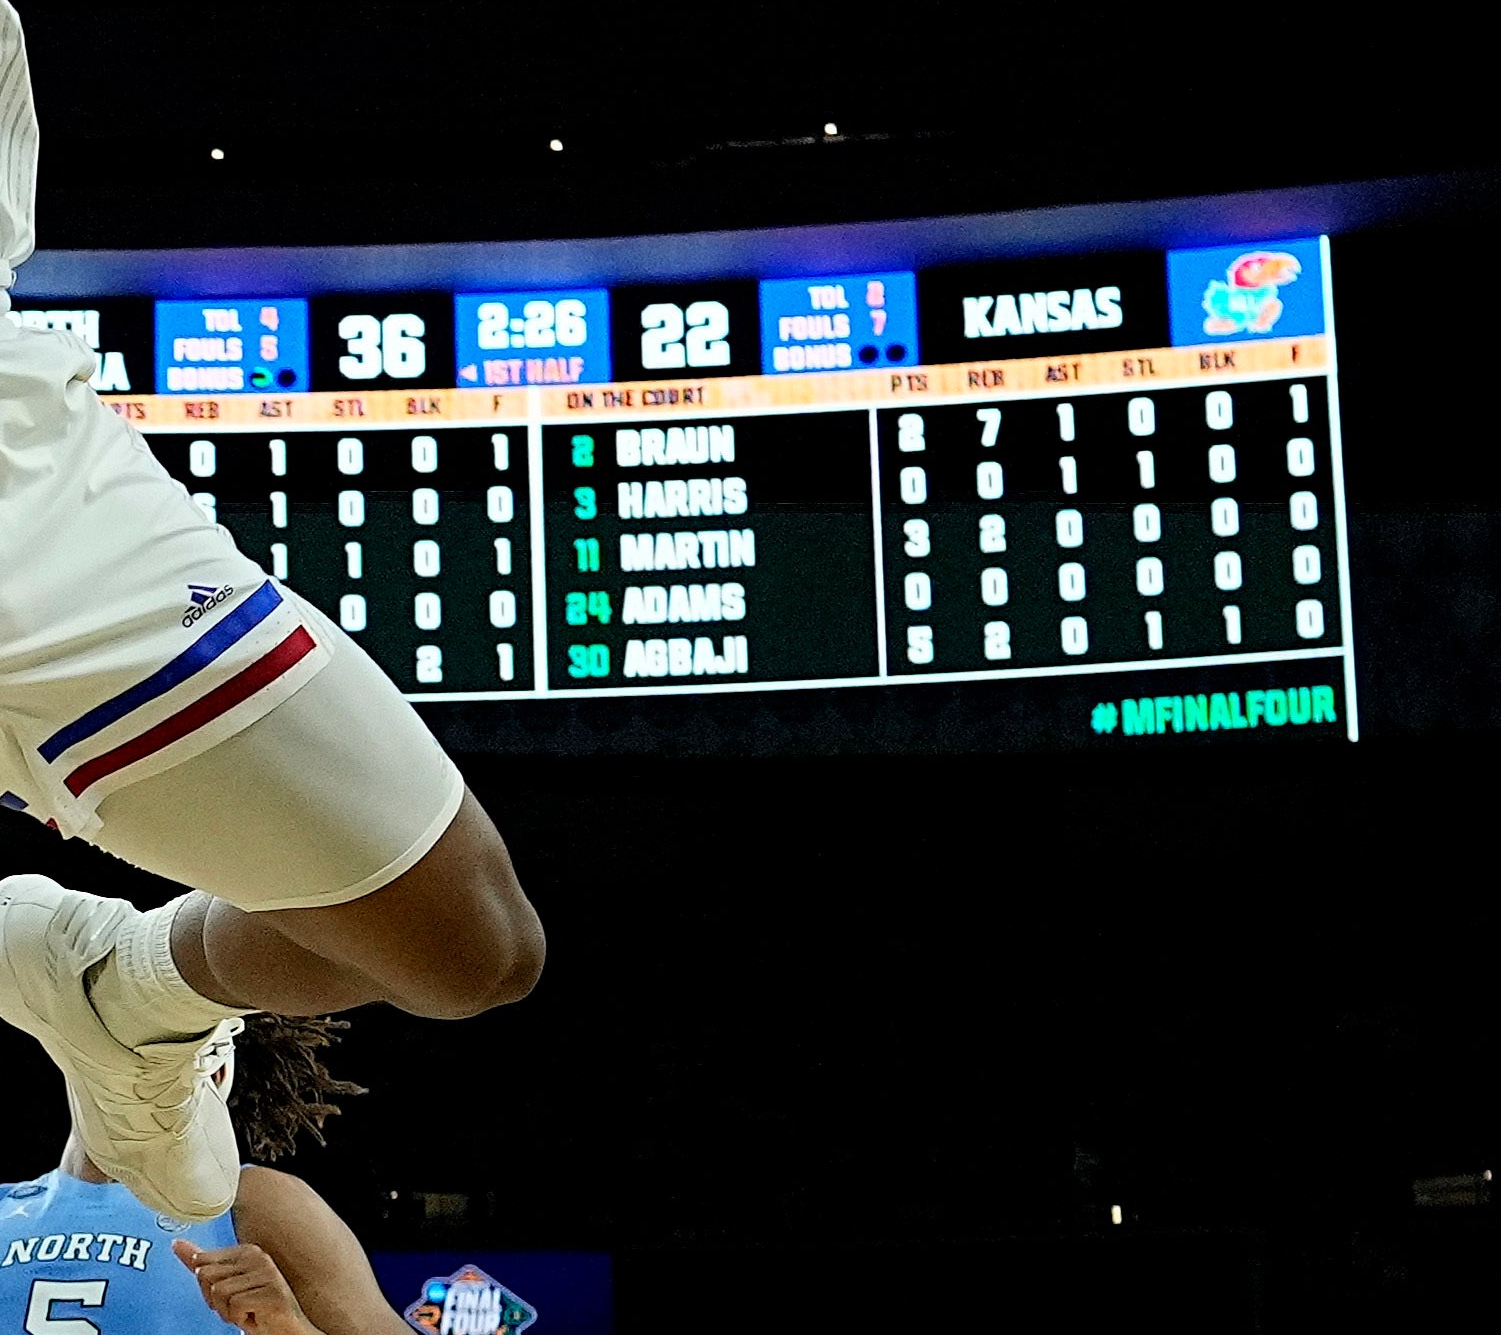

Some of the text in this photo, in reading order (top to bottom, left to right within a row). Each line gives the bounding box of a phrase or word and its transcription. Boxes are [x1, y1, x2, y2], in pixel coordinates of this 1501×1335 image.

[477, 299, 587, 350] 2:26
[778, 309, 887, 341] FOULS 7
[962, 286, 1124, 338] KANSAS
[173, 337, 244, 362] FOULS
[338, 313, 426, 380] 36
[641, 300, 731, 370] 22
[525, 356, 584, 385] HALF
[773, 343, 853, 372] BONUS
[567, 386, 706, 410] ON THE COURT
[891, 373, 928, 393] PTS
[333, 398, 365, 417] STL
[615, 424, 736, 467] BRAUN
[977, 408, 1001, 447] 7
[1057, 403, 1075, 441] 1
[1128, 397, 1155, 436] 0
[1206, 391, 1233, 430] 0
[1289, 384, 1308, 423] 1
[190, 434, 509, 477] 0 1 0 0 1
[618, 477, 748, 519] HARRIS
[900, 467, 927, 504] 0
[977, 462, 1003, 499] 0
[1059, 456, 1077, 494] 1
[1136, 451, 1155, 488] 1
[1209, 444, 1236, 483] 0
[1287, 438, 1315, 476] 0
[270, 486, 513, 528] 1 0 0 0
[573, 538, 600, 572] 11
[620, 528, 755, 572] MARTIN
[904, 519, 930, 557] 3
[1056, 509, 1083, 548] 0
[1133, 503, 1161, 542] 0
[1211, 497, 1239, 536] 0
[1290, 491, 1318, 530] 0
[271, 538, 511, 579] 1 1 0 1
[181, 582, 235, 629] adidas
[565, 545, 1321, 625] 24 ADAMS 0 0 0 0 0 0
[339, 590, 516, 632] 0 0 0
[623, 635, 748, 678] AGBAJI
[907, 626, 934, 664] 5
[1061, 616, 1088, 655] 0
[1145, 611, 1163, 650] 1
[1223, 605, 1241, 644] 1
[1296, 599, 1324, 639] 0
[497, 643, 513, 681] 1
[0, 1231, 154, 1273] NORTH
